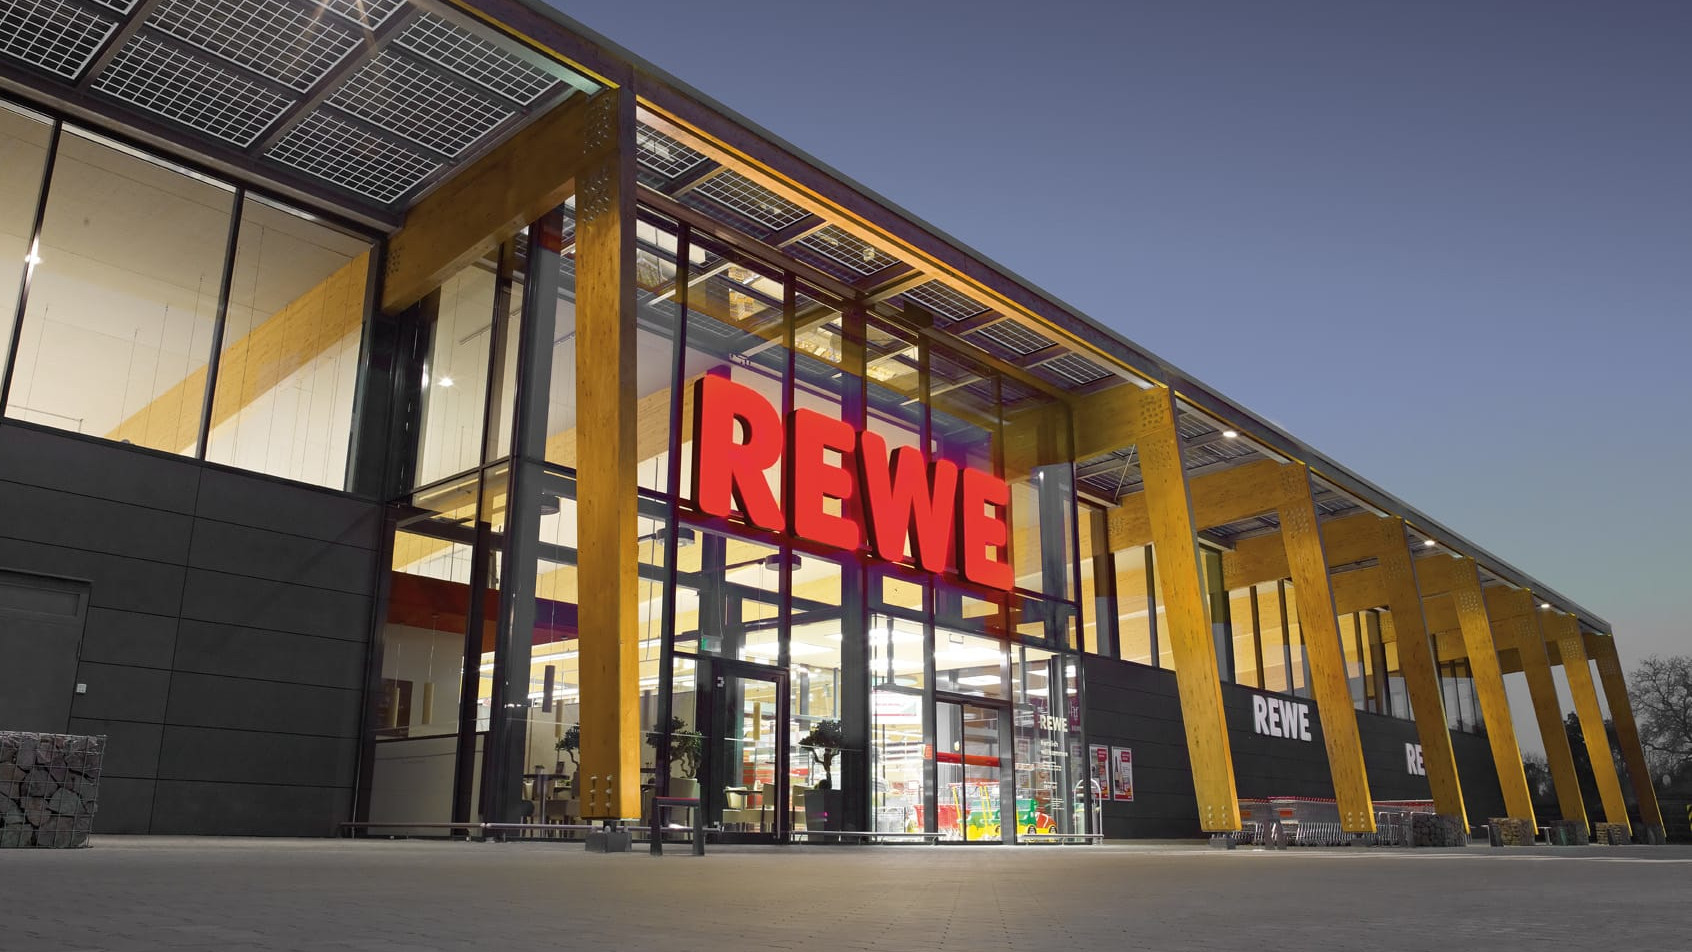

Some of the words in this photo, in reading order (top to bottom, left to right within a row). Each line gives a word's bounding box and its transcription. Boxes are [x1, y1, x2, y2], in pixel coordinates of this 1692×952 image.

[695, 373, 1015, 591] REWE
[1039, 714, 1068, 732] REWE
[1253, 694, 1312, 742] REWE
[1405, 742, 1426, 776] RE
